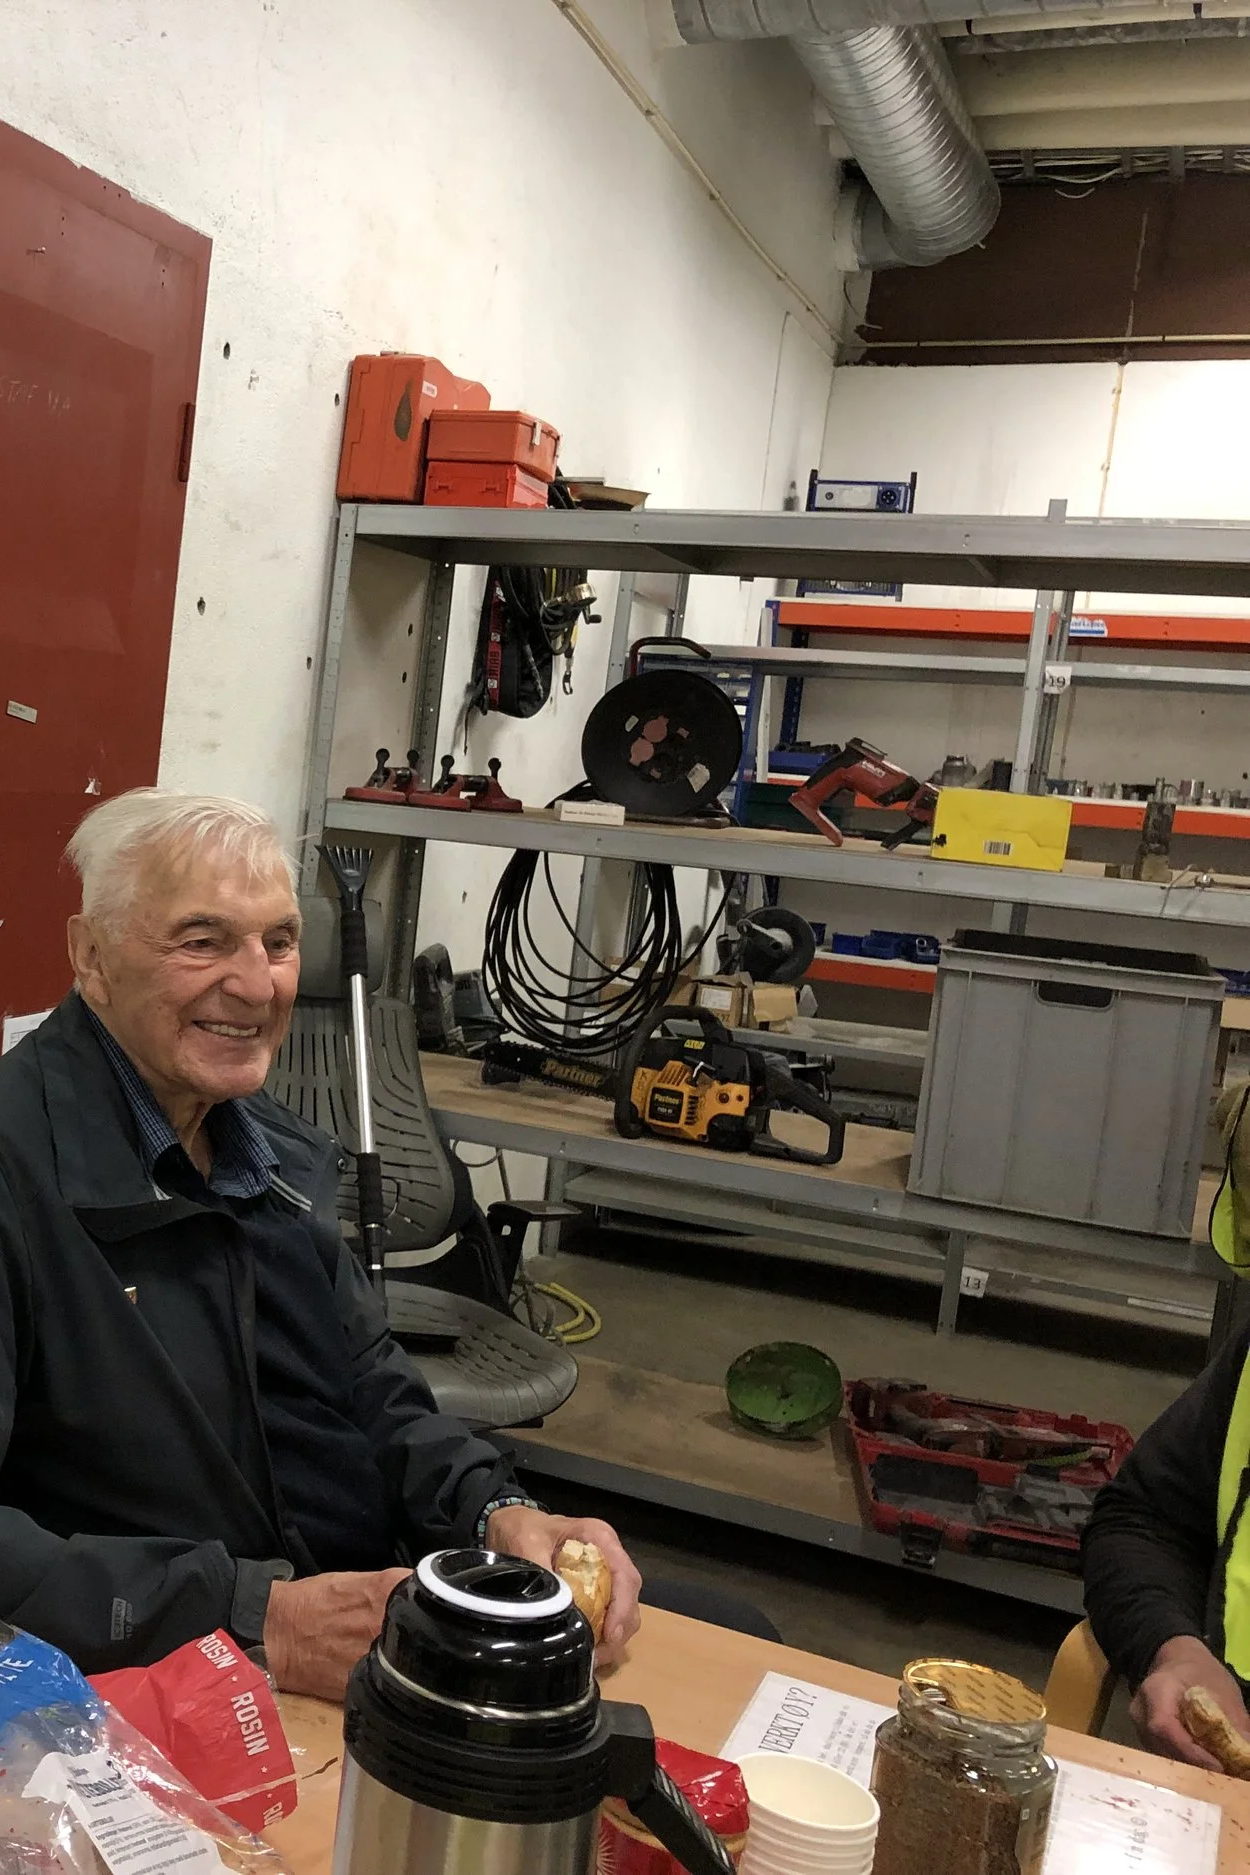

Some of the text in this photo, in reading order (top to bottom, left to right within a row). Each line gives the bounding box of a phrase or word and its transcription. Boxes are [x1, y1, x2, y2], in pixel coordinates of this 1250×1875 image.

[1050, 675, 1066, 688] 19
[965, 1276, 981, 1289] 13
[196, 1633, 239, 1670] ROSIN
[230, 1691, 270, 1756] ROSIN
